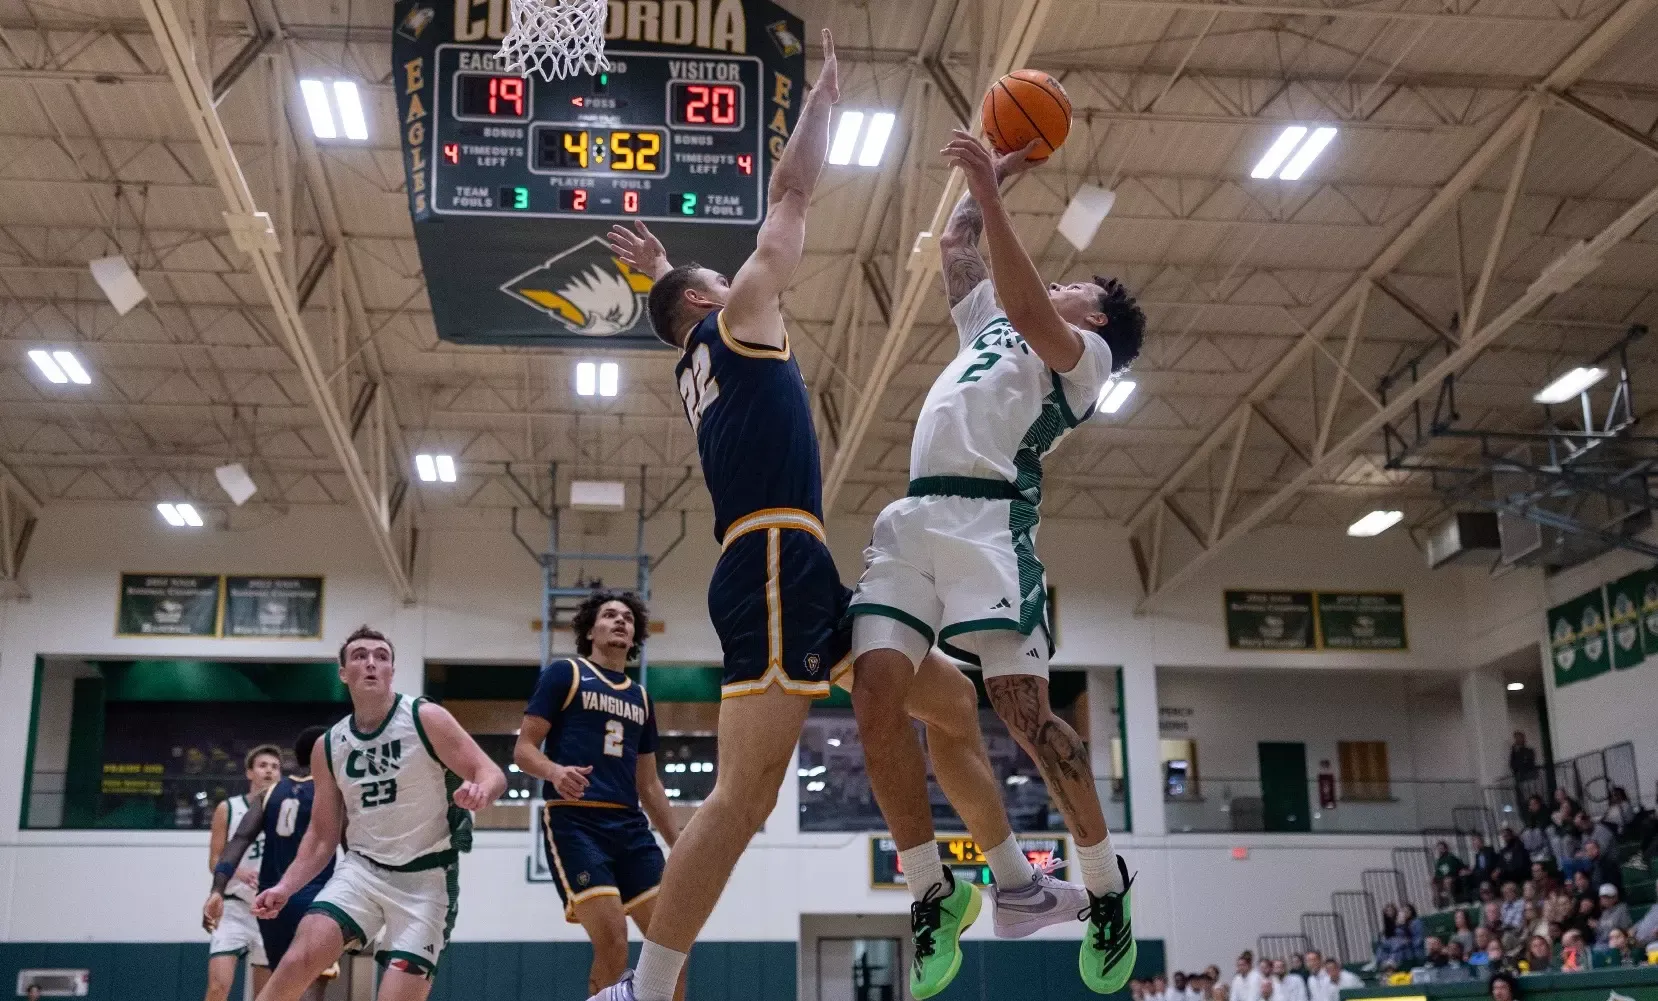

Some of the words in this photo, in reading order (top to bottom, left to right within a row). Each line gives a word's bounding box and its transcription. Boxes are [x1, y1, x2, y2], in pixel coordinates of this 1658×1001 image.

[668, 60, 740, 80] VISITOR
[489, 78, 523, 115] 19
[584, 98, 616, 108] POSS
[686, 86, 735, 124] 20
[767, 71, 793, 160] EAG
[483, 127, 524, 139] BONUS
[673, 134, 714, 146] BONUS
[444, 144, 458, 164] 4
[462, 144, 524, 157] TIMEOUTS
[564, 131, 660, 172] 4:52
[673, 153, 736, 165] TIMEOUTS
[477, 157, 507, 167] LEFT
[689, 164, 719, 174] LEFT
[737, 154, 752, 174] 4
[455, 186, 489, 197] TEAM
[550, 178, 595, 188] PLAYER
[611, 179, 652, 189] FOULS
[453, 197, 493, 208] FOULS
[513, 187, 529, 209] 3
[573, 189, 587, 211] 2
[624, 191, 639, 213] 0
[681, 192, 697, 215] 2
[707, 194, 740, 205] TEAM
[704, 205, 744, 216] FOULS
[956, 352, 1002, 383] 2
[581, 690, 645, 726] VANGUARD
[603, 719, 625, 758] 2
[361, 778, 397, 809] 23
[276, 798, 300, 837] 0
